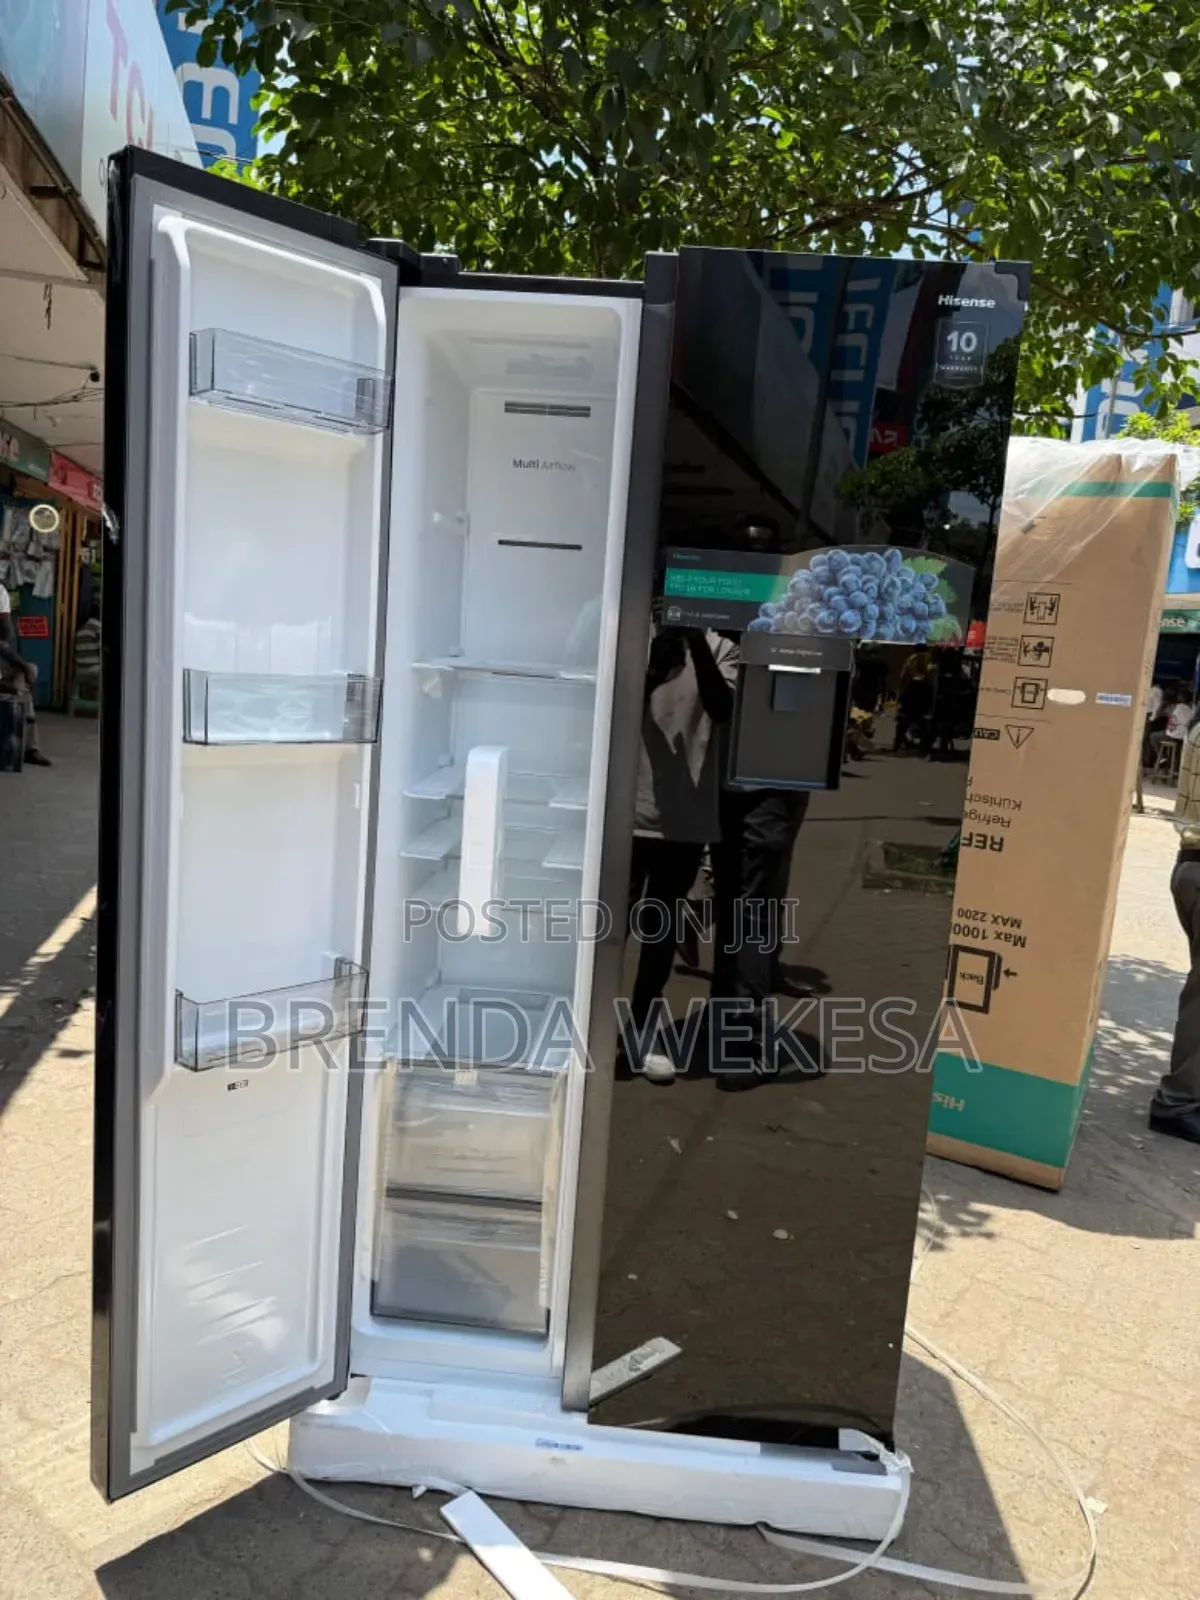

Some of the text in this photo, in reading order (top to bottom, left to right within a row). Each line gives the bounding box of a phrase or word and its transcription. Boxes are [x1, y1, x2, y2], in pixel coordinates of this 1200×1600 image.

[938, 294, 997, 308] Hisense
[947, 330, 978, 353] 10
[512, 458, 539, 469] Multi
[961, 832, 1004, 852] REF
[957, 907, 1023, 930] MAX 2200
[953, 922, 1027, 948] Max 1000
[960, 971, 984, 985] Back
